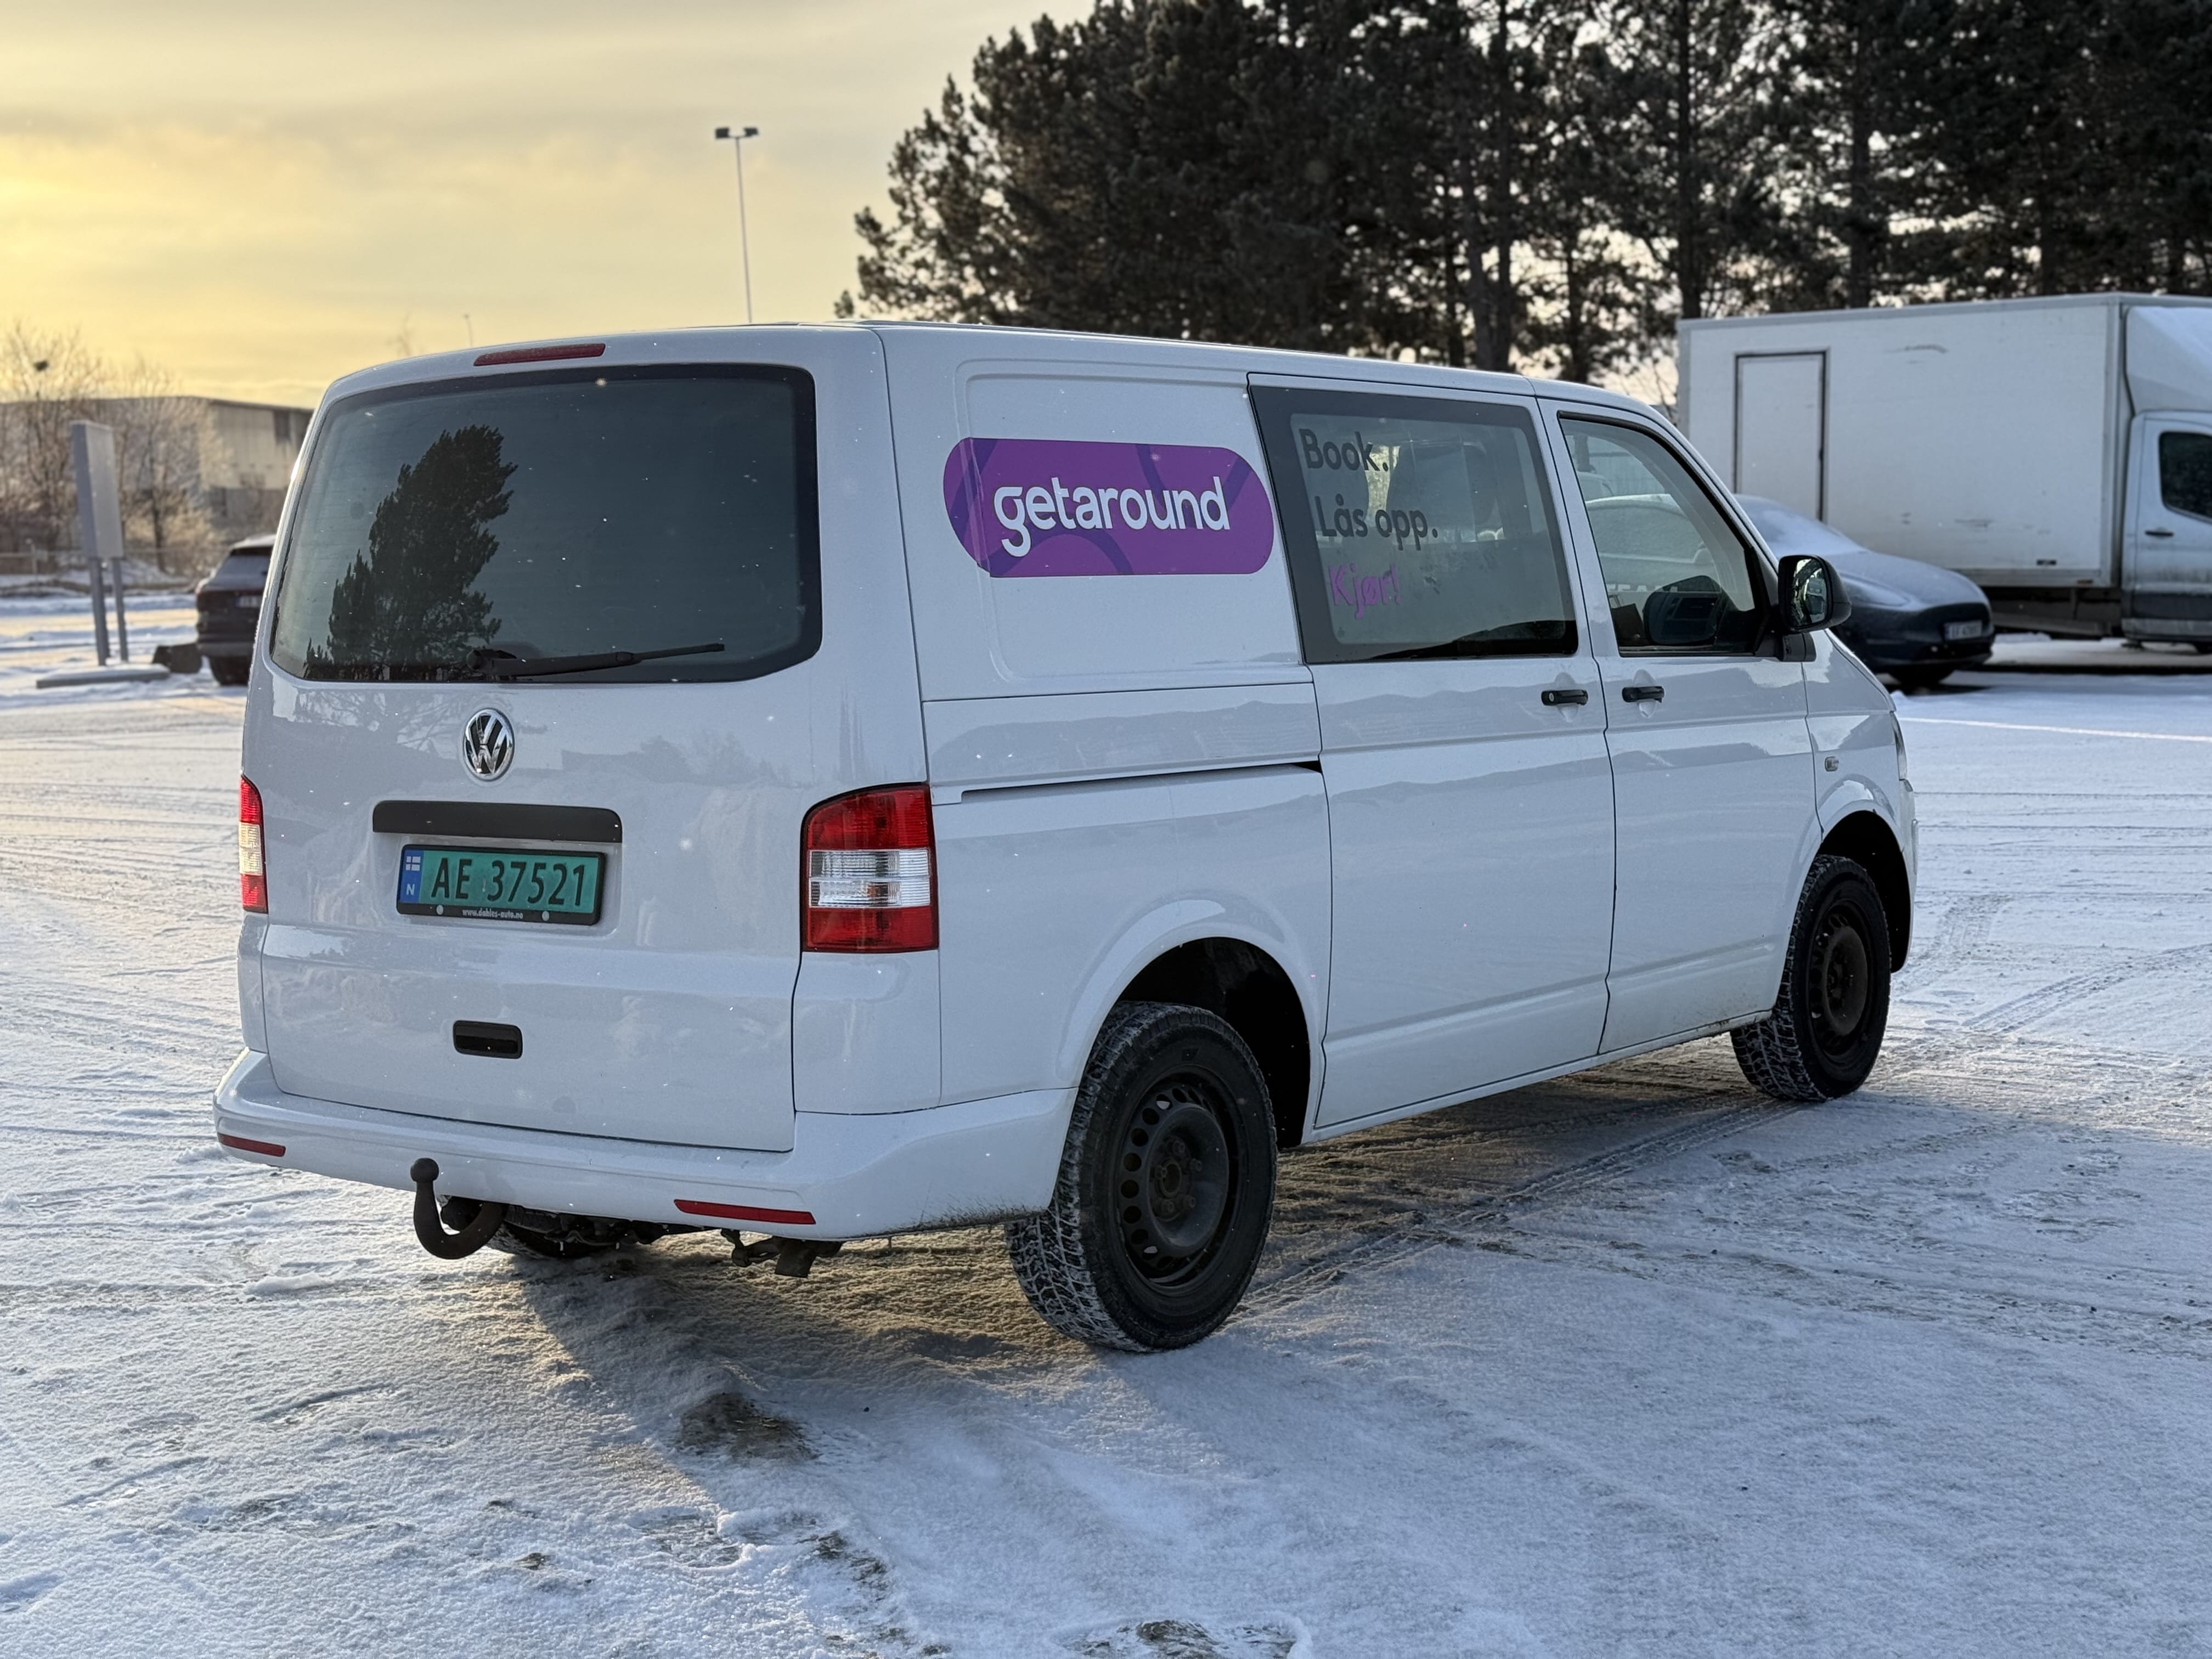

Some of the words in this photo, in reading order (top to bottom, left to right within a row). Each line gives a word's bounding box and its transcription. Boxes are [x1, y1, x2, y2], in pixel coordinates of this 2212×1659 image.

[1299, 428, 1389, 472] Book.
[993, 476, 1231, 558] getaround
[1314, 493, 1369, 538] Lås
[1375, 509, 1438, 551] opp.
[1328, 563, 1402, 619] Kjør!
[405, 883, 415, 896] N
[431, 857, 472, 900] AE
[487, 860, 585, 906] 37521
